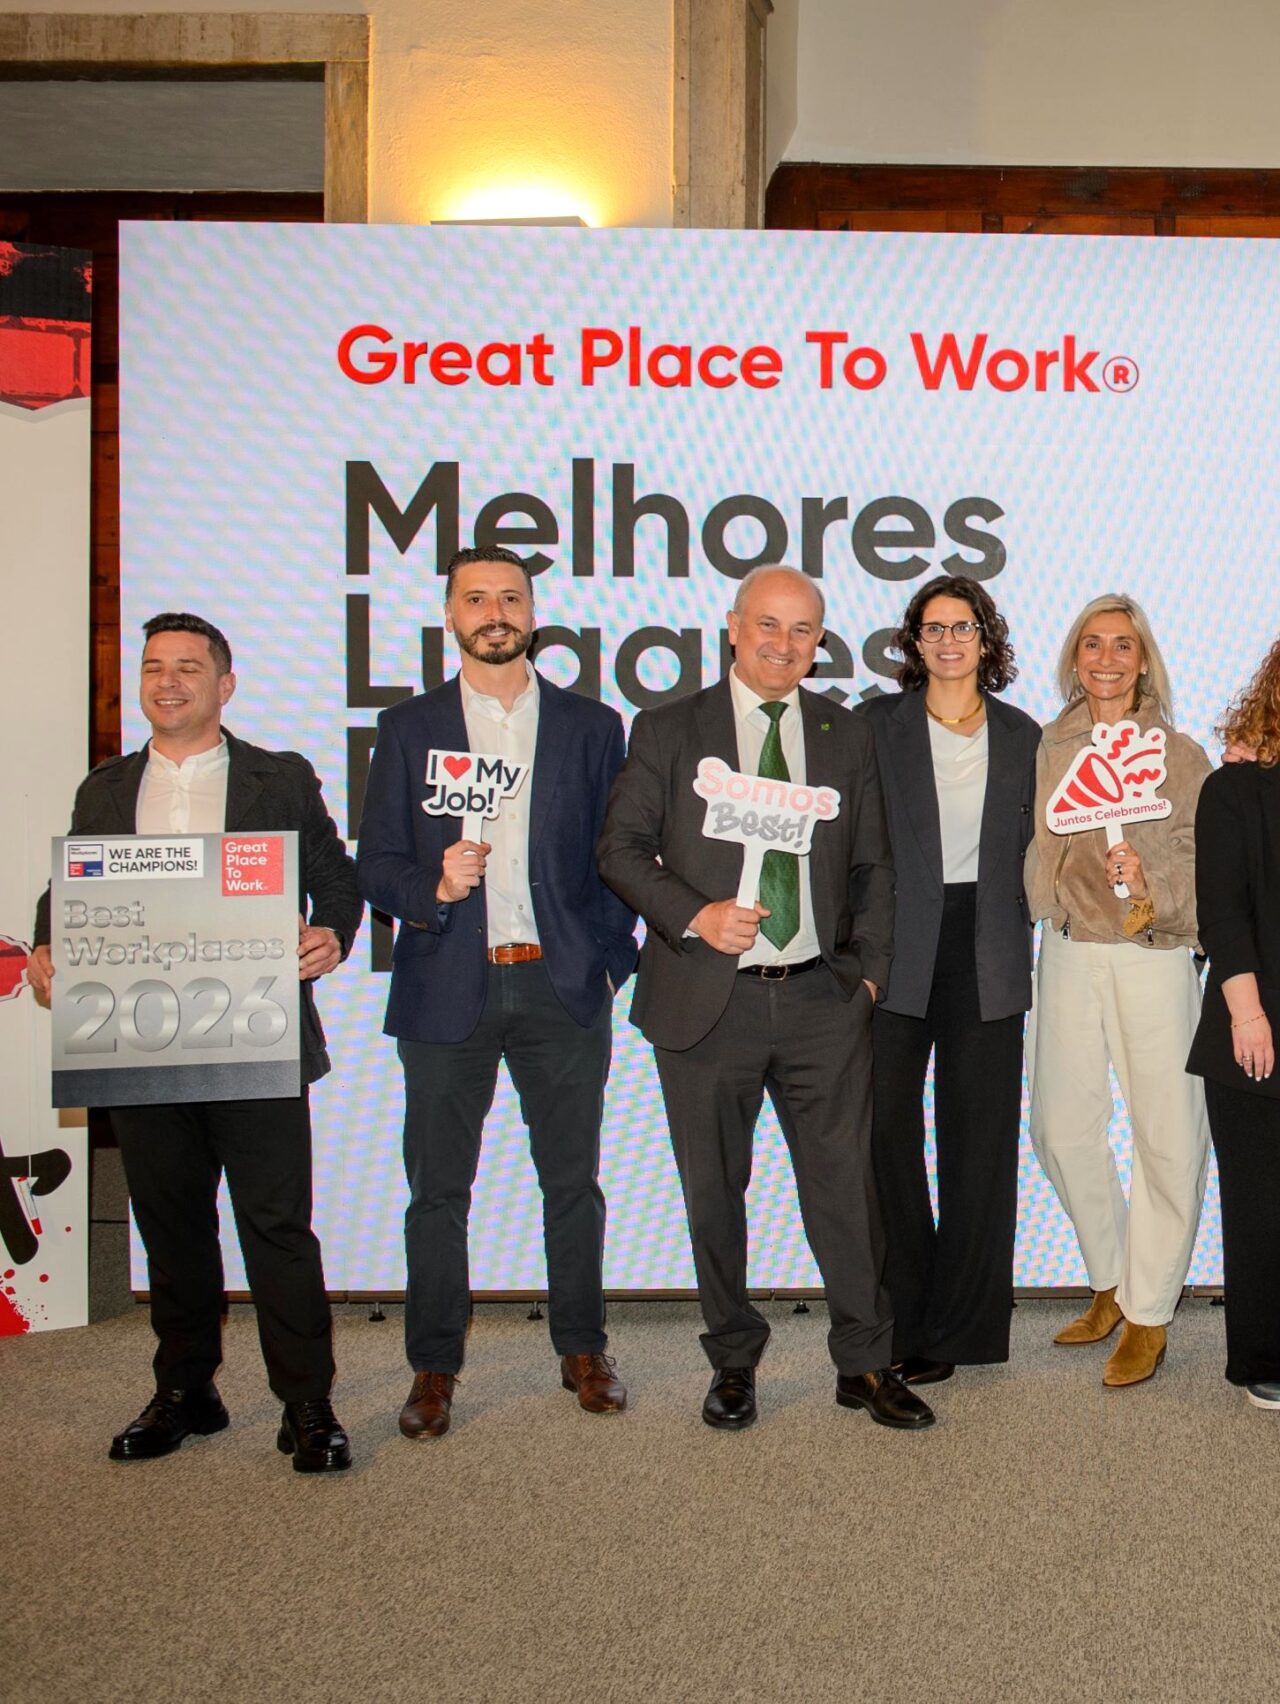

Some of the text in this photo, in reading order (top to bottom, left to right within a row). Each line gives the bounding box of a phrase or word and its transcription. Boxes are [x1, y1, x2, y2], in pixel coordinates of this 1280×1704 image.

[337, 324, 555, 387] Great
[580, 326, 783, 390] Place
[805, 331, 888, 391] To
[345, 458, 1006, 582] Melhores
[430, 754, 521, 792] I My
[427, 784, 495, 814] Job!
[699, 761, 835, 816] Somos
[710, 802, 809, 849] Best!
[1054, 800, 1167, 828] Juntos Celebramos!
[108, 847, 191, 859] WE ARE THE
[225, 841, 268, 854] Great
[226, 854, 268, 866] Place
[108, 859, 198, 874] CHAMPIONS!
[225, 867, 242, 879] To
[63, 899, 145, 929] Best
[62, 932, 286, 971] Workplaces
[63, 975, 288, 1054] 2026
